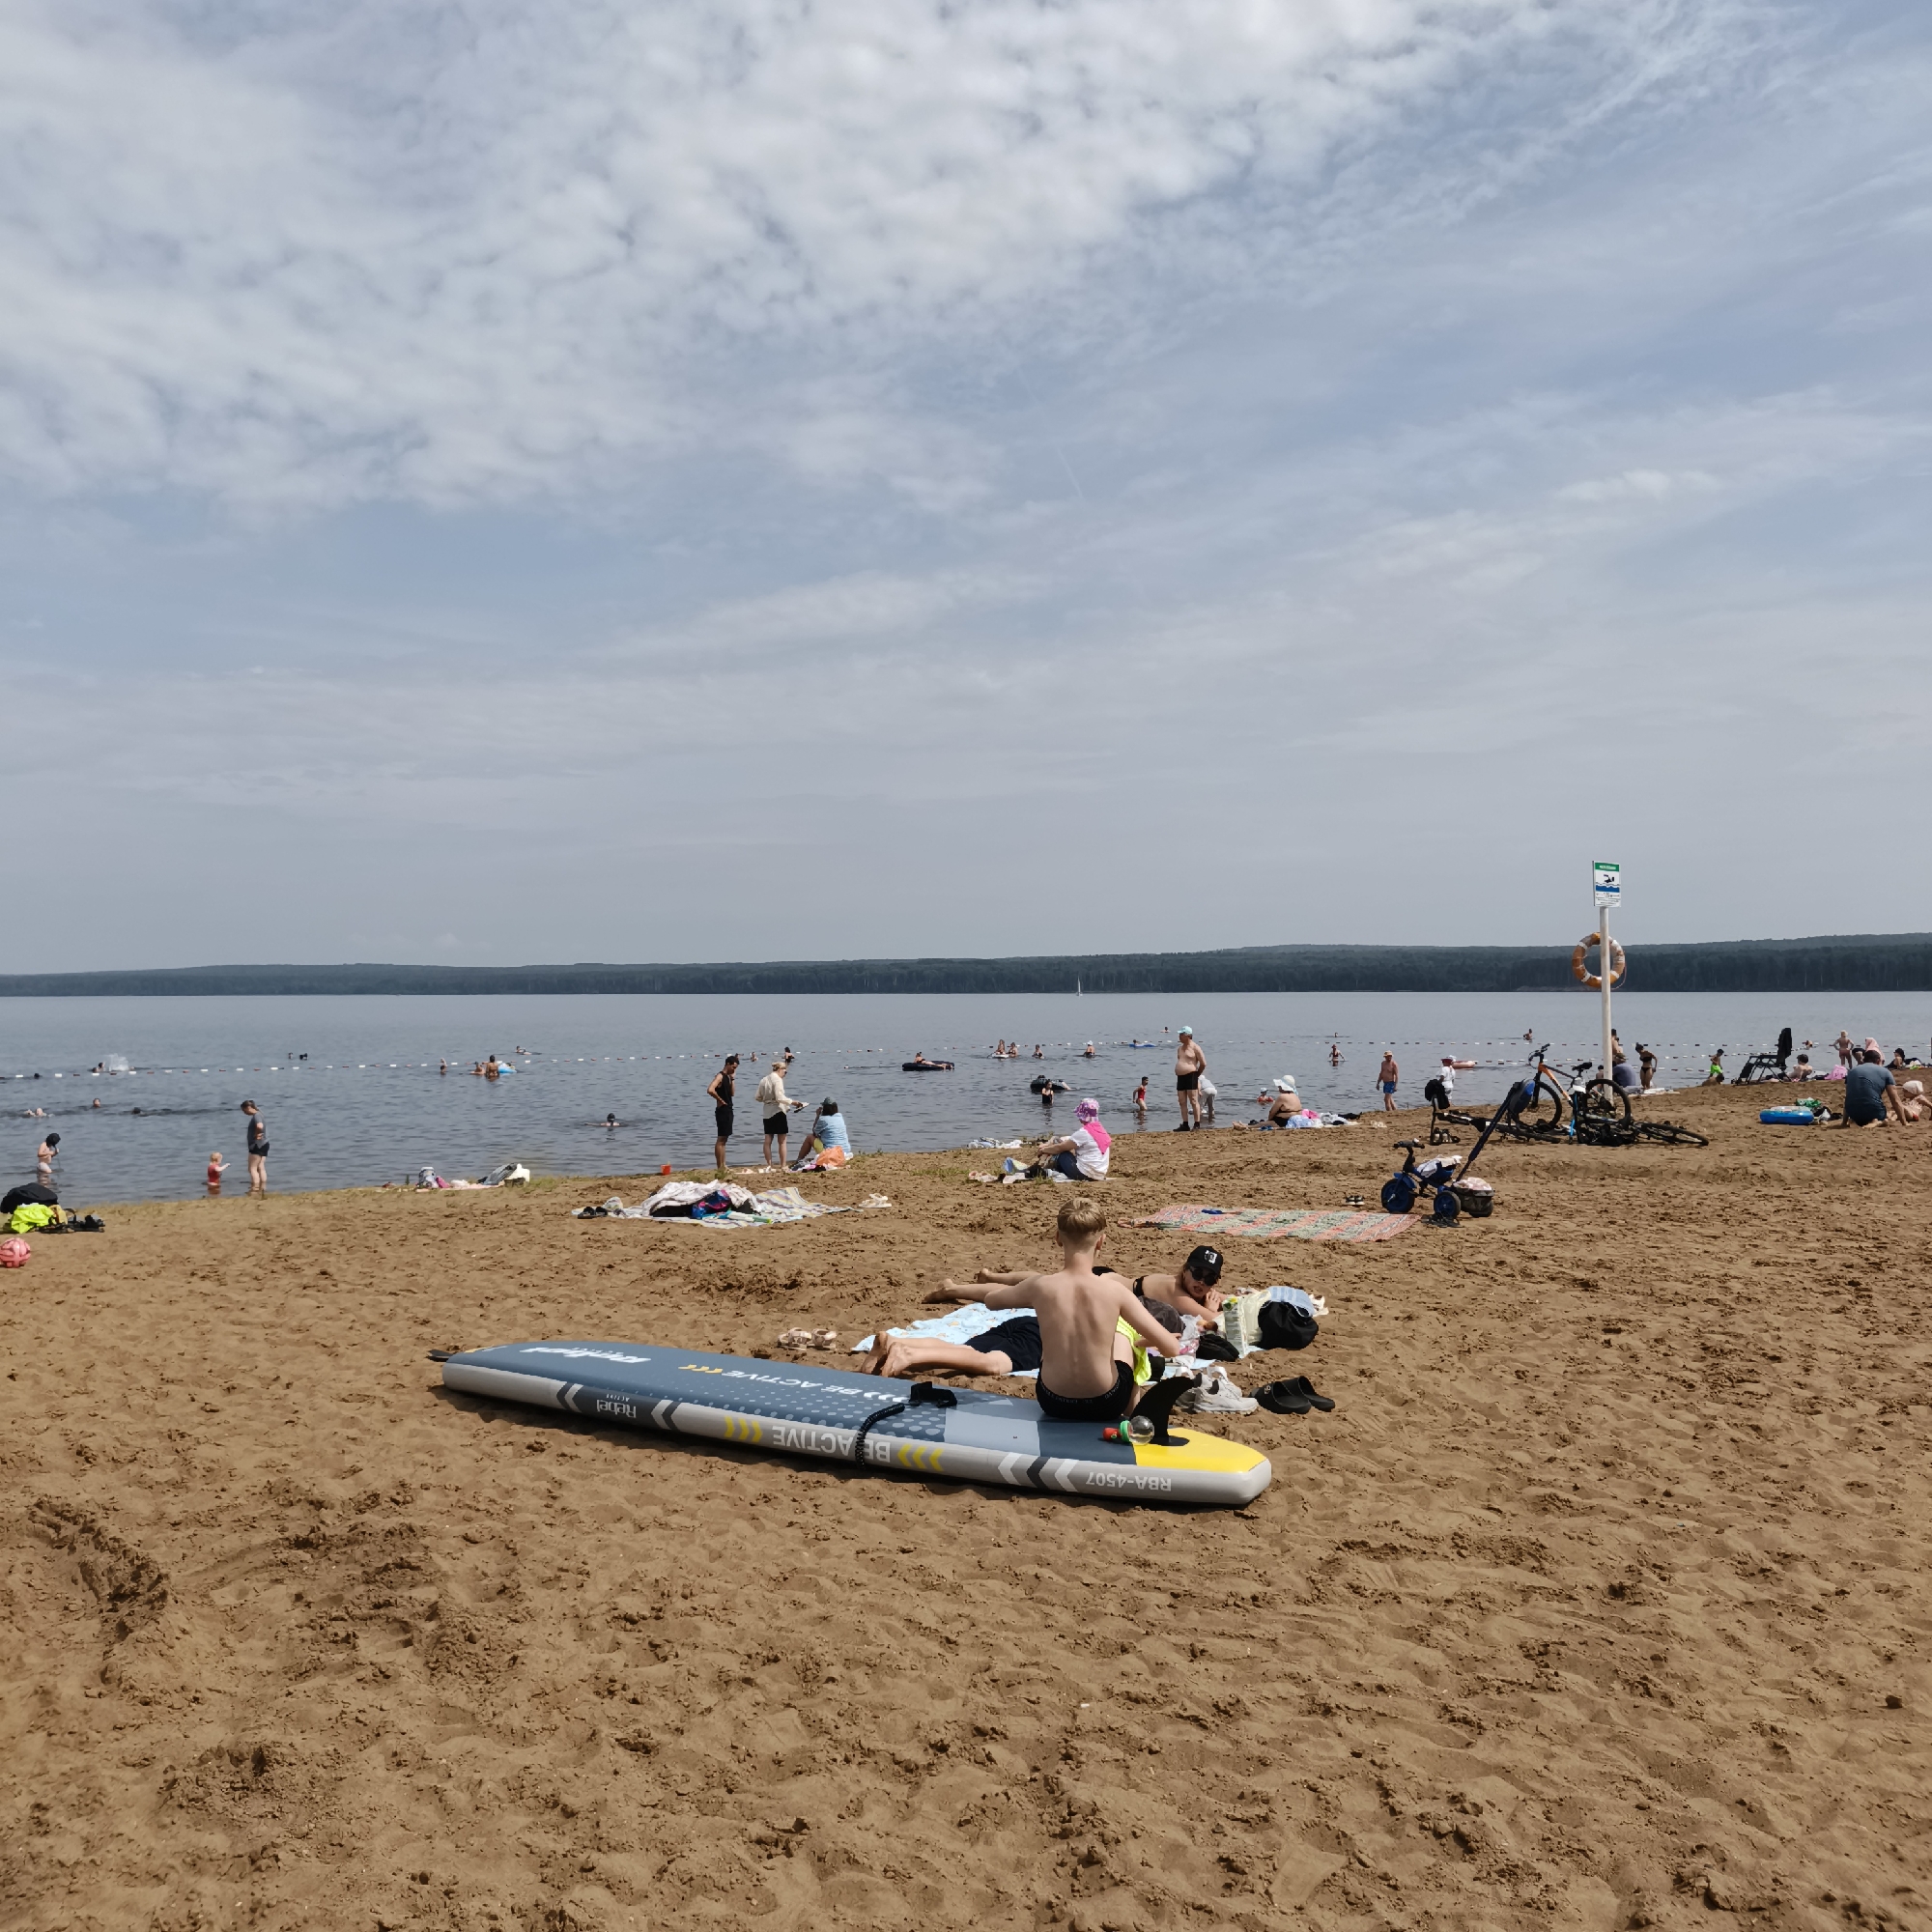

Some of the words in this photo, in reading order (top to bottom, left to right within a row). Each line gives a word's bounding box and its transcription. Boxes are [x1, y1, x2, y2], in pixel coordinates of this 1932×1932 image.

[721, 1370, 823, 1388] ACTIVE
[596, 1399, 637, 1419] Rebel
[771, 1426, 854, 1457] ACTIVE
[1085, 1471, 1172, 1492] RBA-4507
